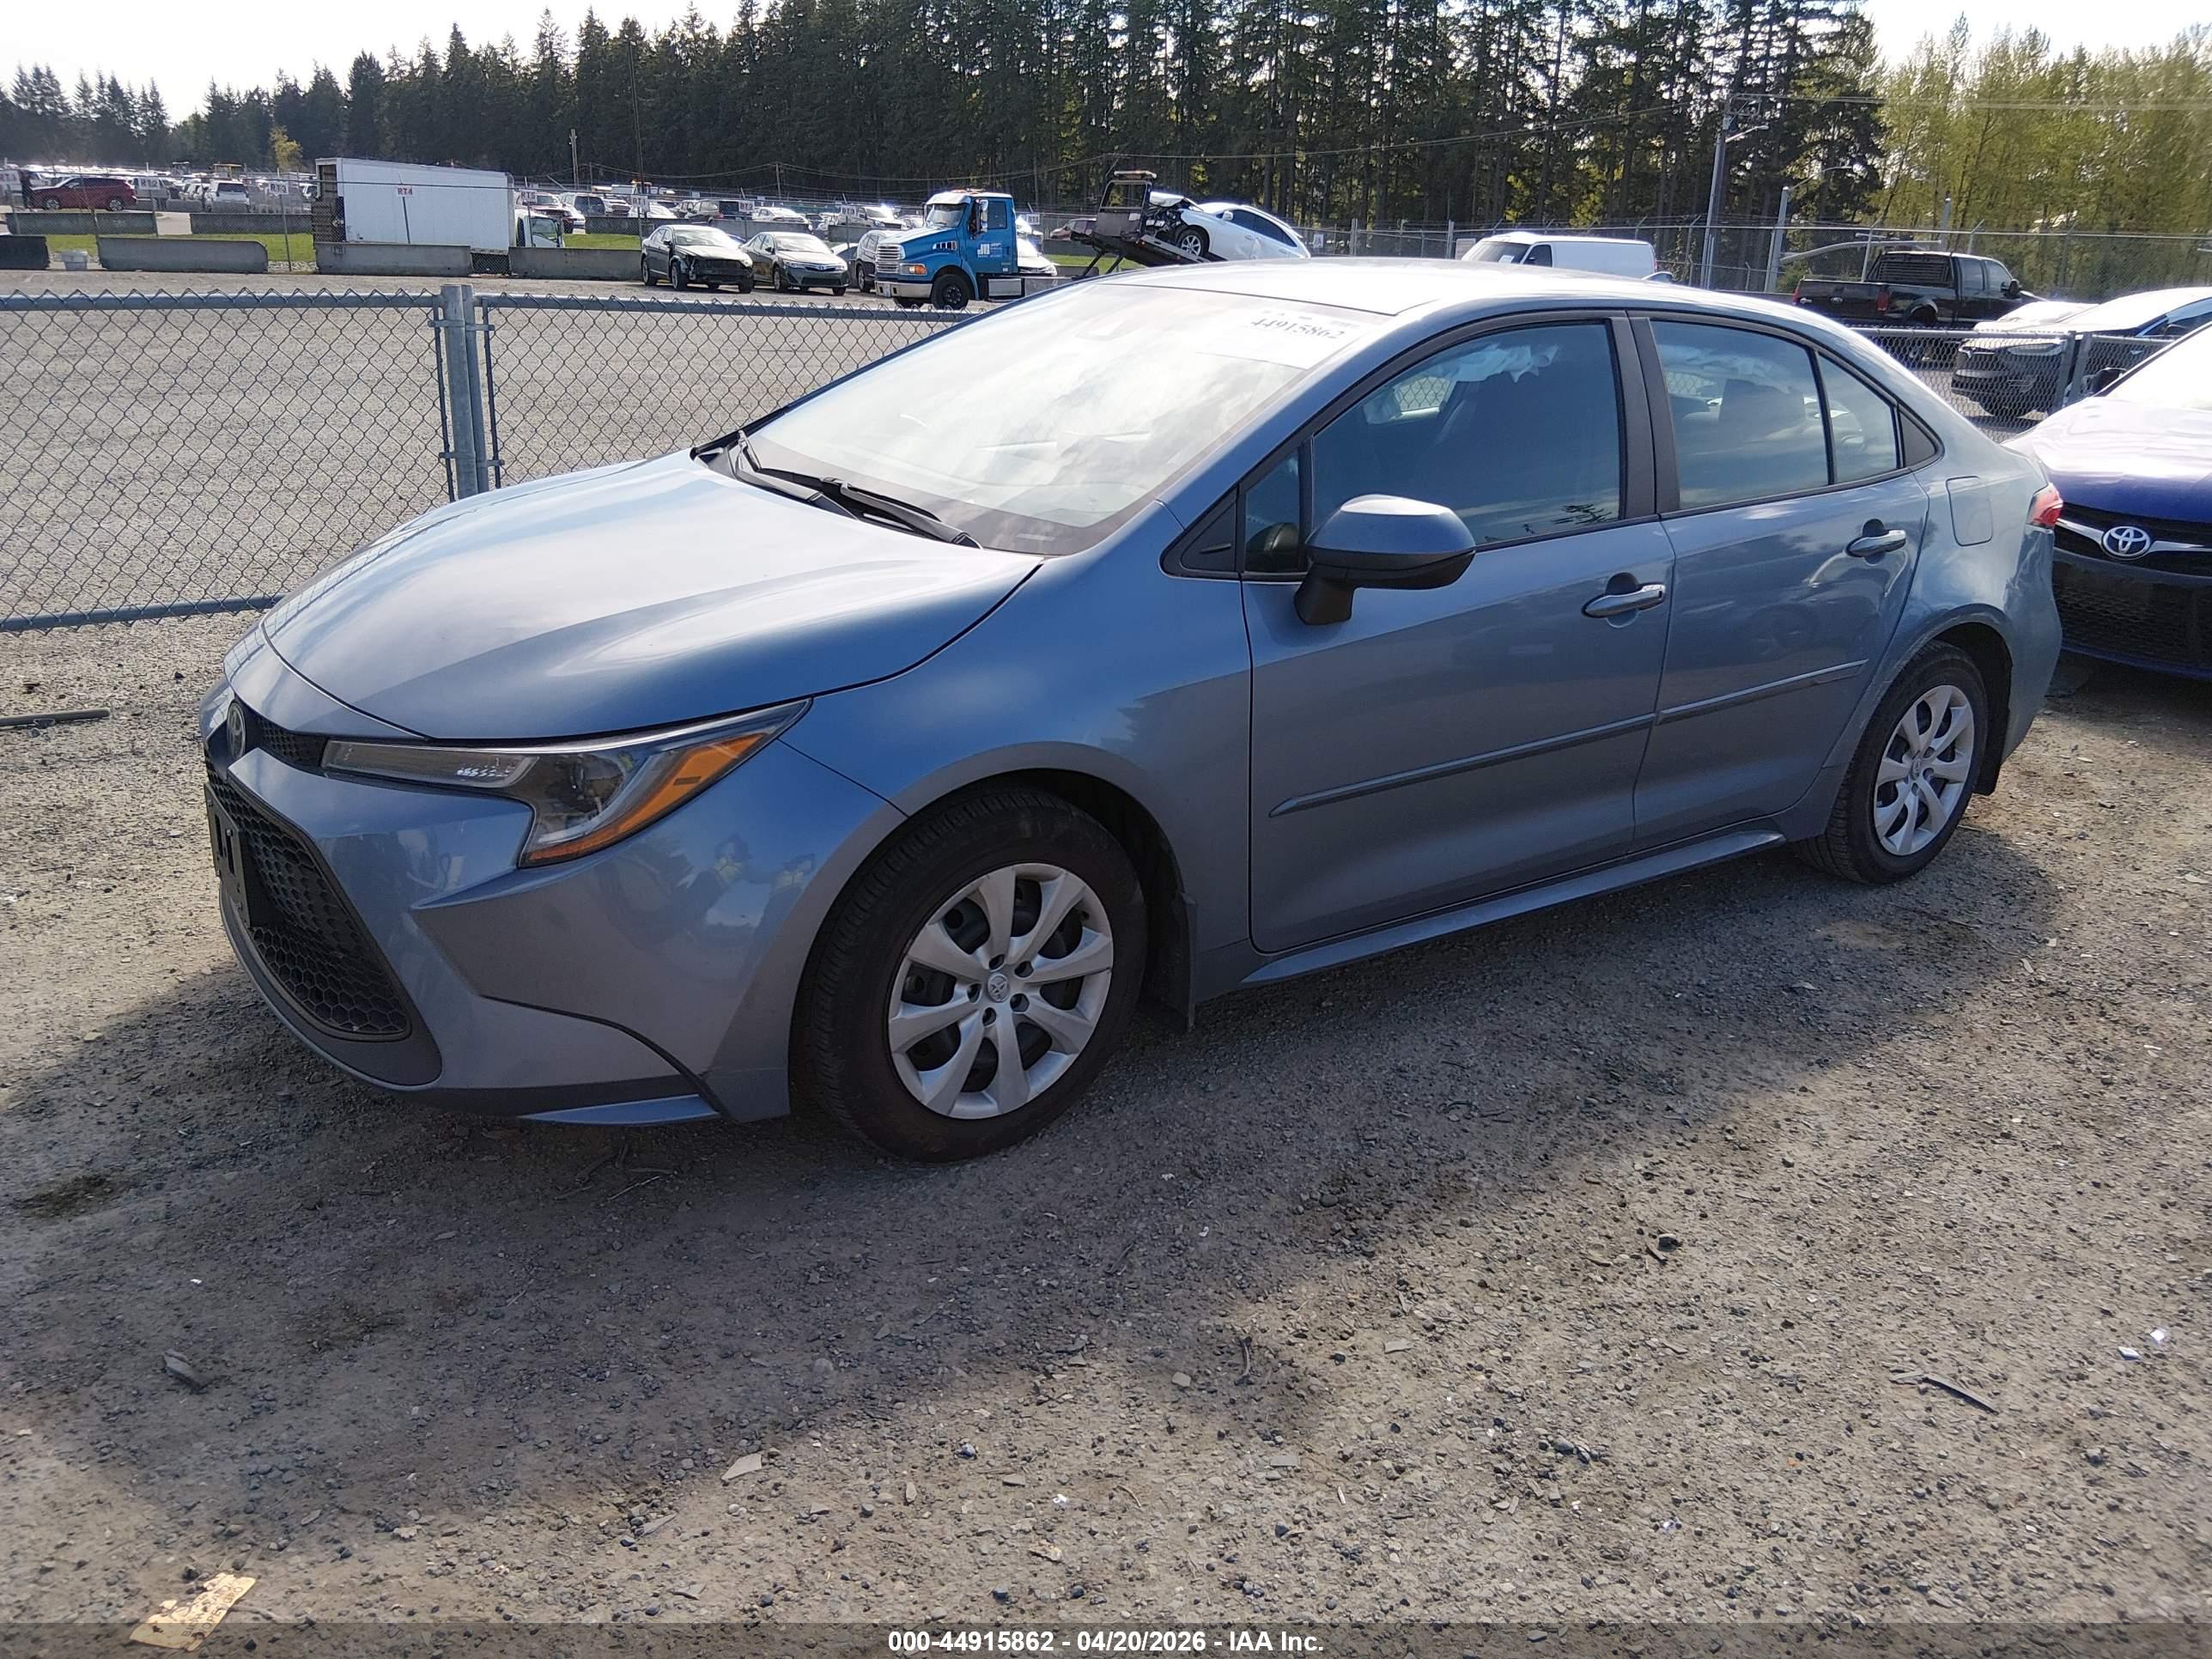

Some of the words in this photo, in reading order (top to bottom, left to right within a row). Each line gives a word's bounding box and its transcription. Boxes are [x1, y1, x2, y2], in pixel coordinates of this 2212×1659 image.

[141, 178, 158, 187] RT2
[270, 183, 288, 193] RT3
[520, 191, 536, 199] RT5
[1250, 318, 1346, 339] 44915862
